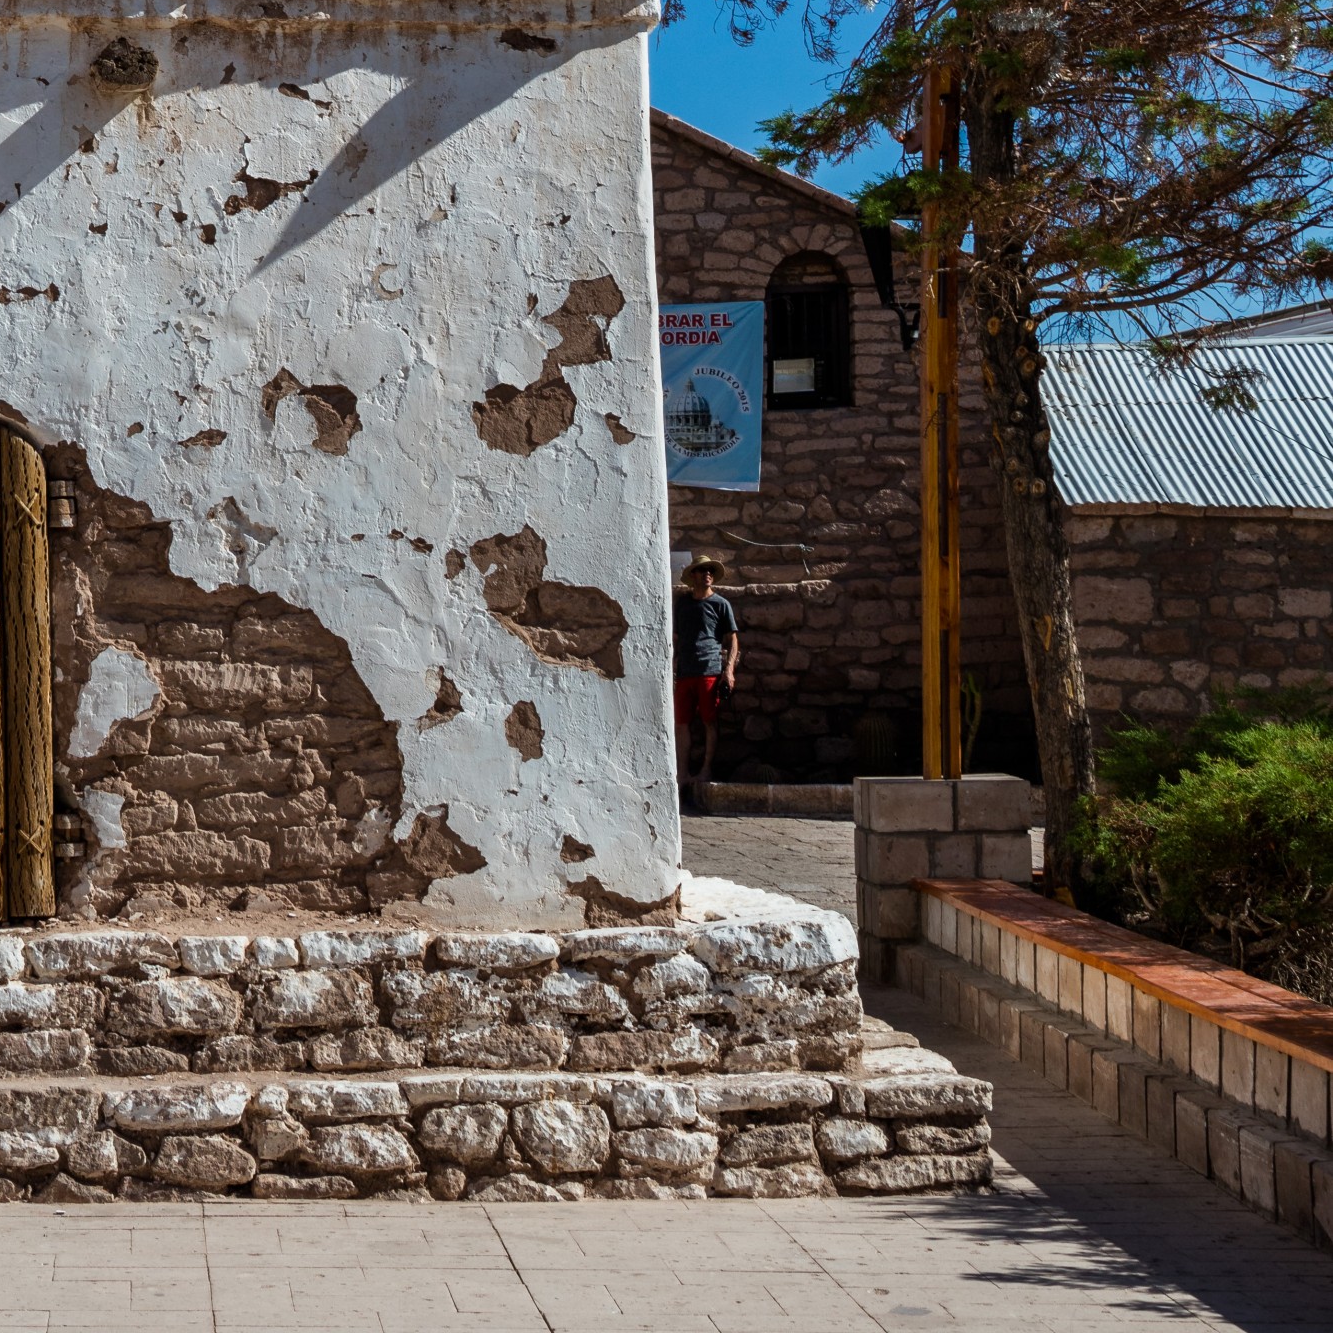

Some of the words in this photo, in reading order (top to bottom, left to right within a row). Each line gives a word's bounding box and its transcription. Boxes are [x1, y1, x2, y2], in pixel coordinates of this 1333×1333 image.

[710, 314, 733, 327] EL
[694, 368, 740, 389] JUBILEO
[737, 390, 750, 412] 2015
[664, 433, 672, 445] DE
[672, 443, 682, 453] LA
[683, 436, 740, 458] MISERICORDIA
